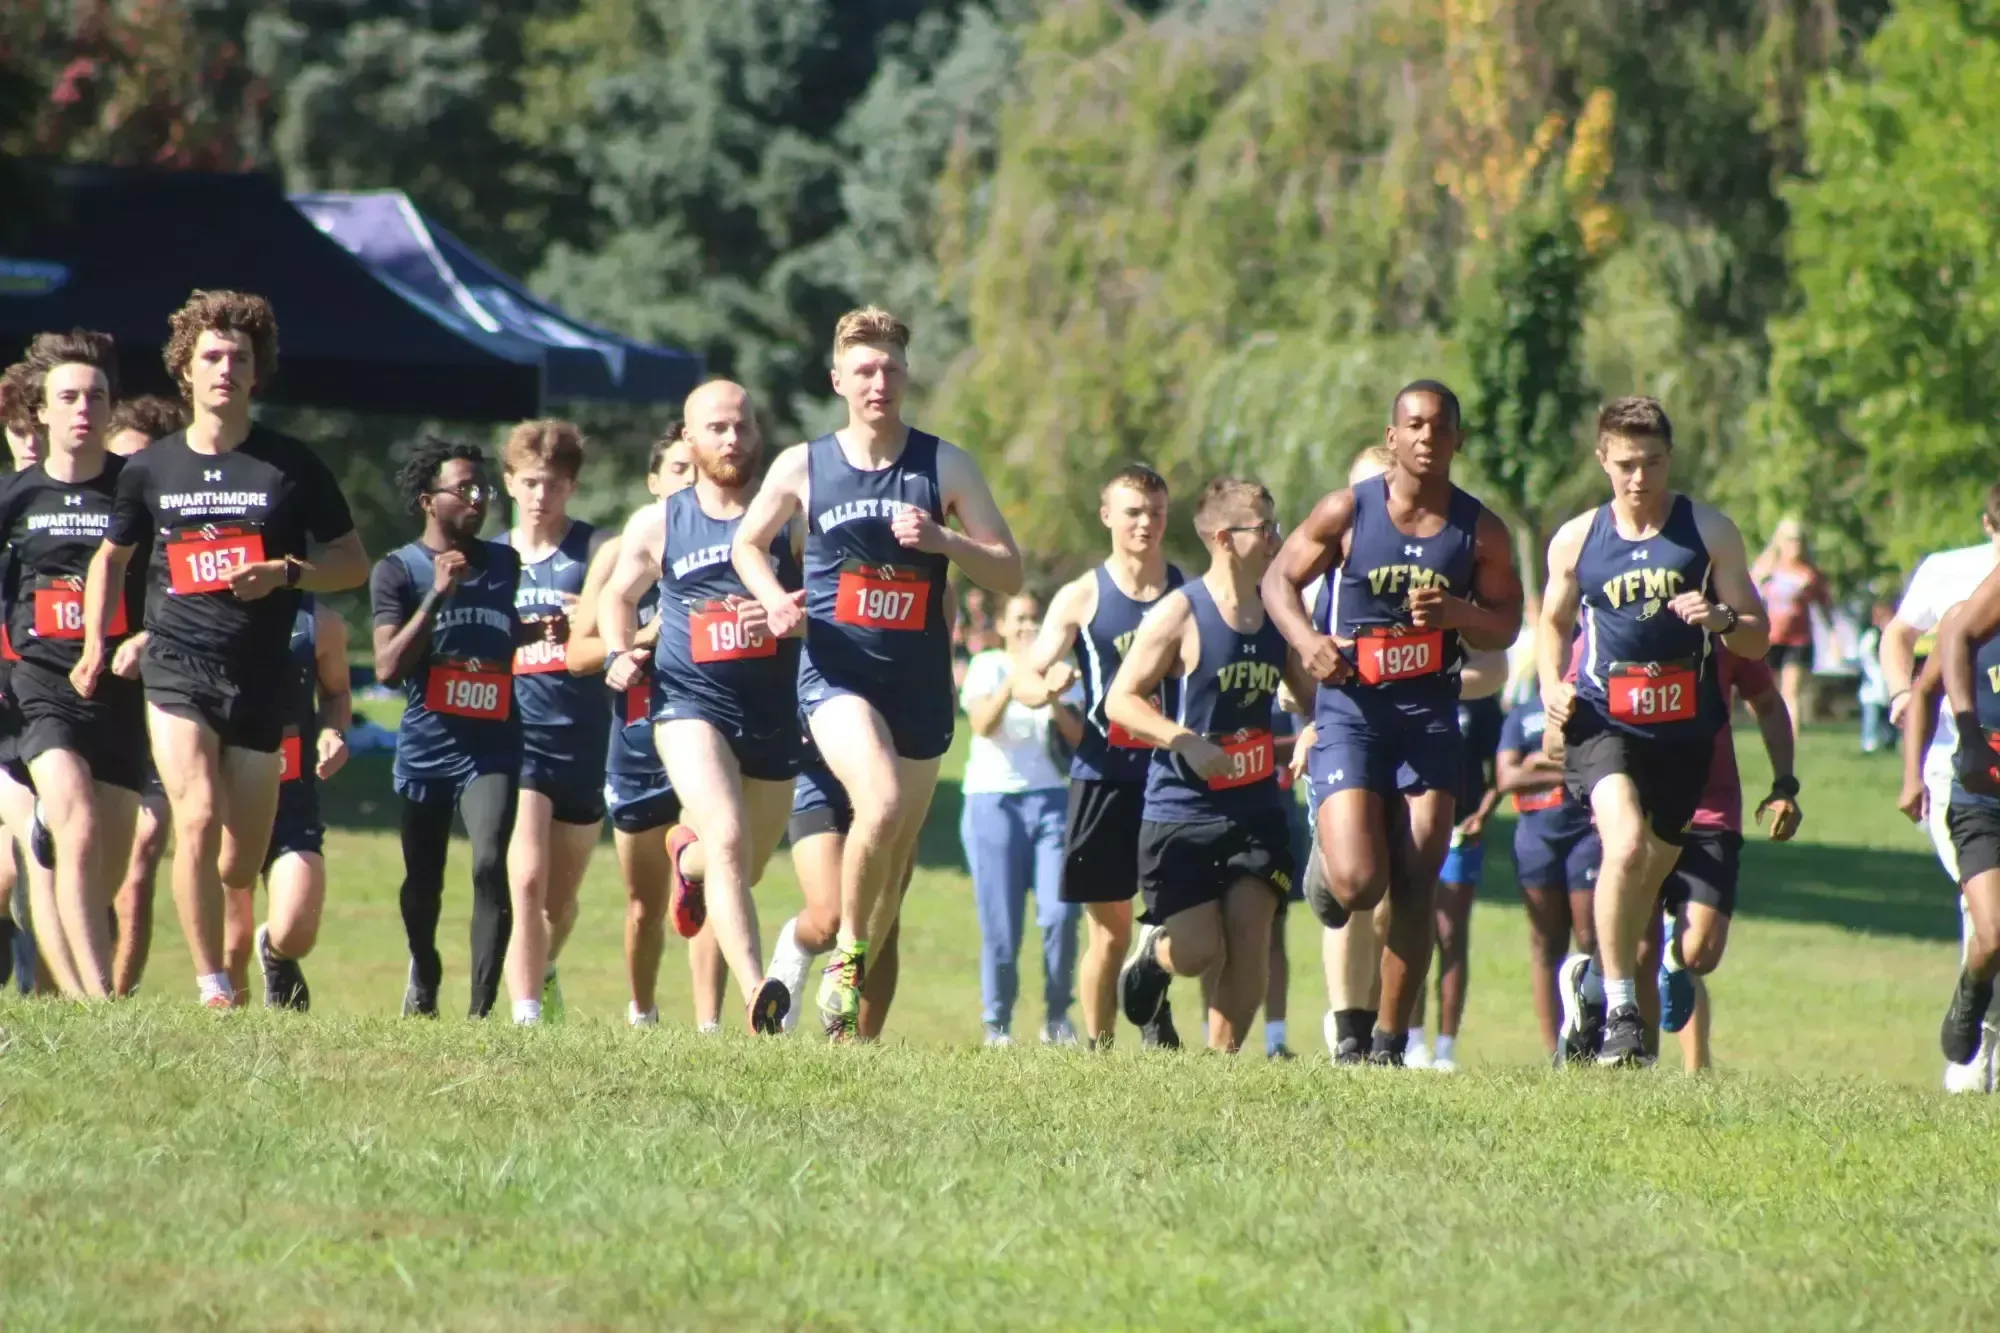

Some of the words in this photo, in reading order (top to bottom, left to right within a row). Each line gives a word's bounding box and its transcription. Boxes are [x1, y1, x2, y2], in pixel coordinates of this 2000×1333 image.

[160, 492, 267, 509] SWARTHMORE
[180, 507, 207, 516] CROSS
[209, 506, 247, 515] COUNTRY
[818, 499, 878, 534] VALLEY
[27, 514, 109, 529] SWARTHMO
[49, 528, 75, 536] TRACK
[83, 528, 104, 536] FIELD
[186, 547, 246, 583] 1857
[52, 601, 85, 630] 18
[856, 587, 915, 621] 1907
[1373, 643, 1430, 675] 1920
[1217, 660, 1280, 693] VFMC
[445, 680, 498, 710] 1908
[1628, 683, 1692, 715] 1912
[1227, 745, 1265, 780] 917
